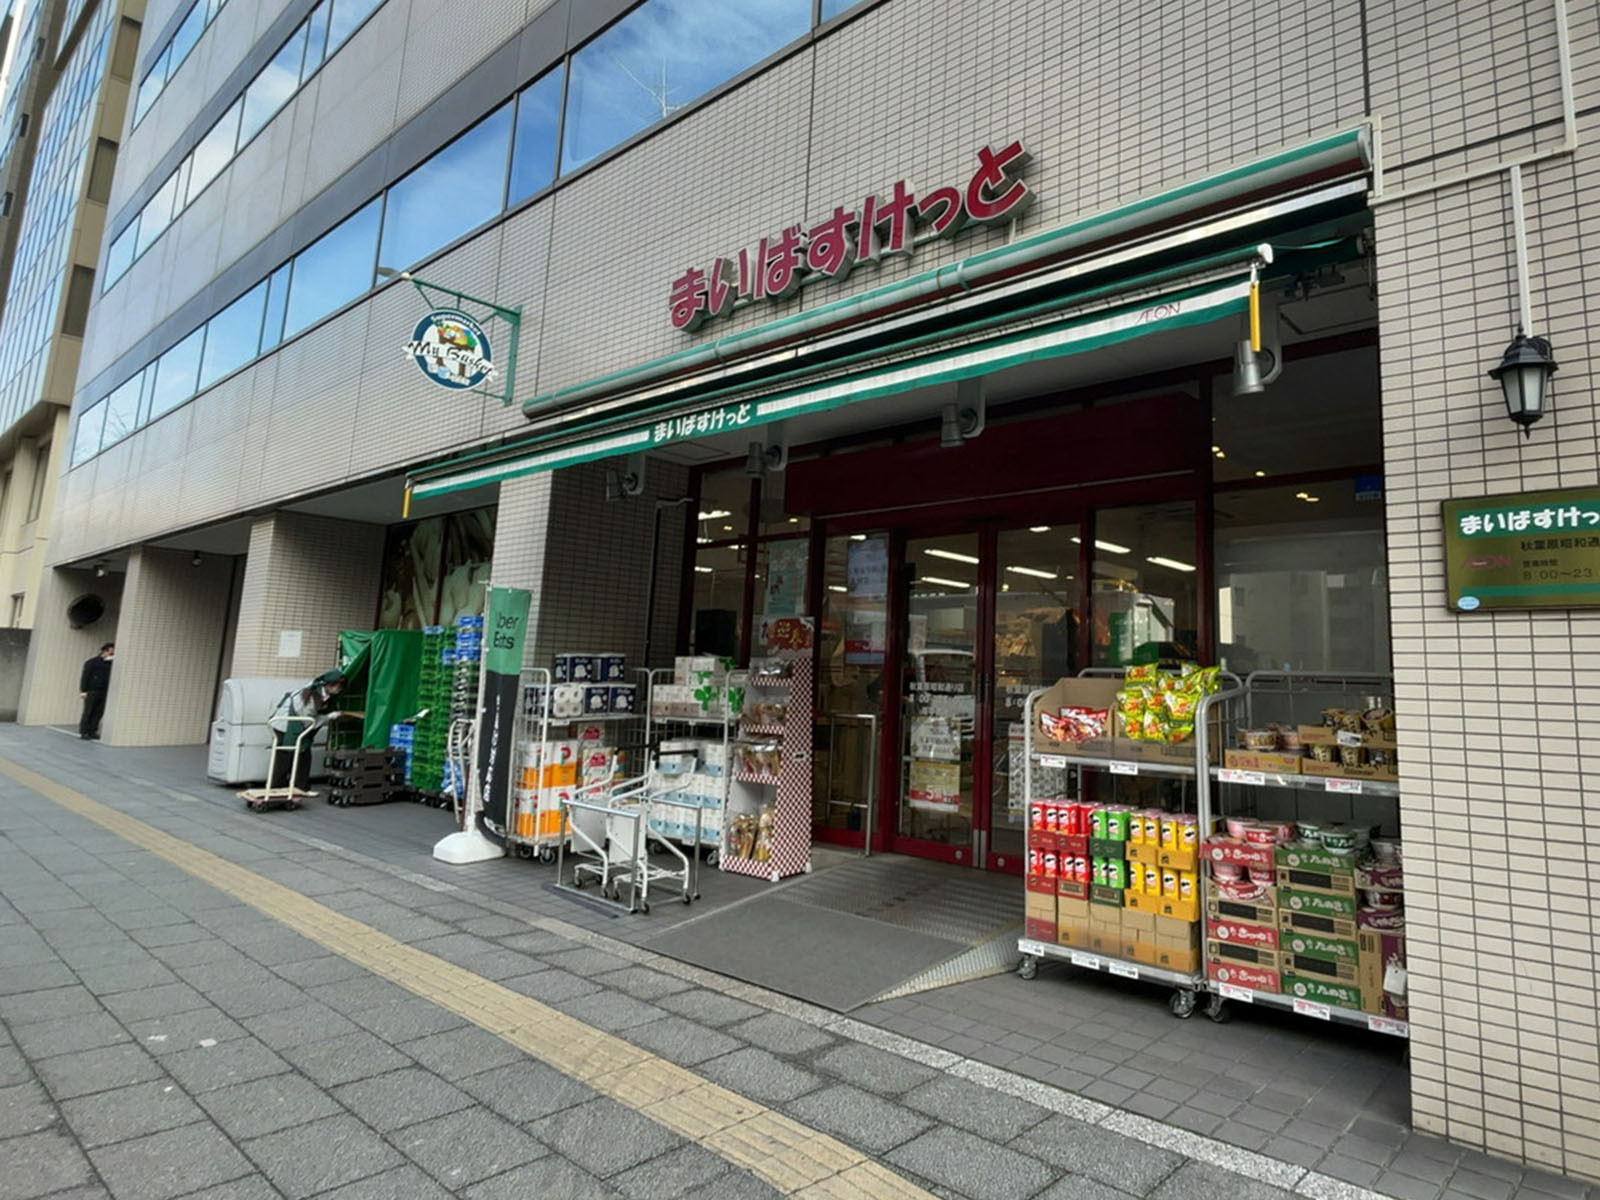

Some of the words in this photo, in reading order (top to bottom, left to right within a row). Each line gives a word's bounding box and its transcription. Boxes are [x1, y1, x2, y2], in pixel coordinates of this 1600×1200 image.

[668, 140, 1031, 331] まいばすけっと
[407, 341, 440, 358] My
[446, 346, 493, 376] Basket
[653, 403, 751, 443] まいばすけっと
[495, 611, 520, 630] ber
